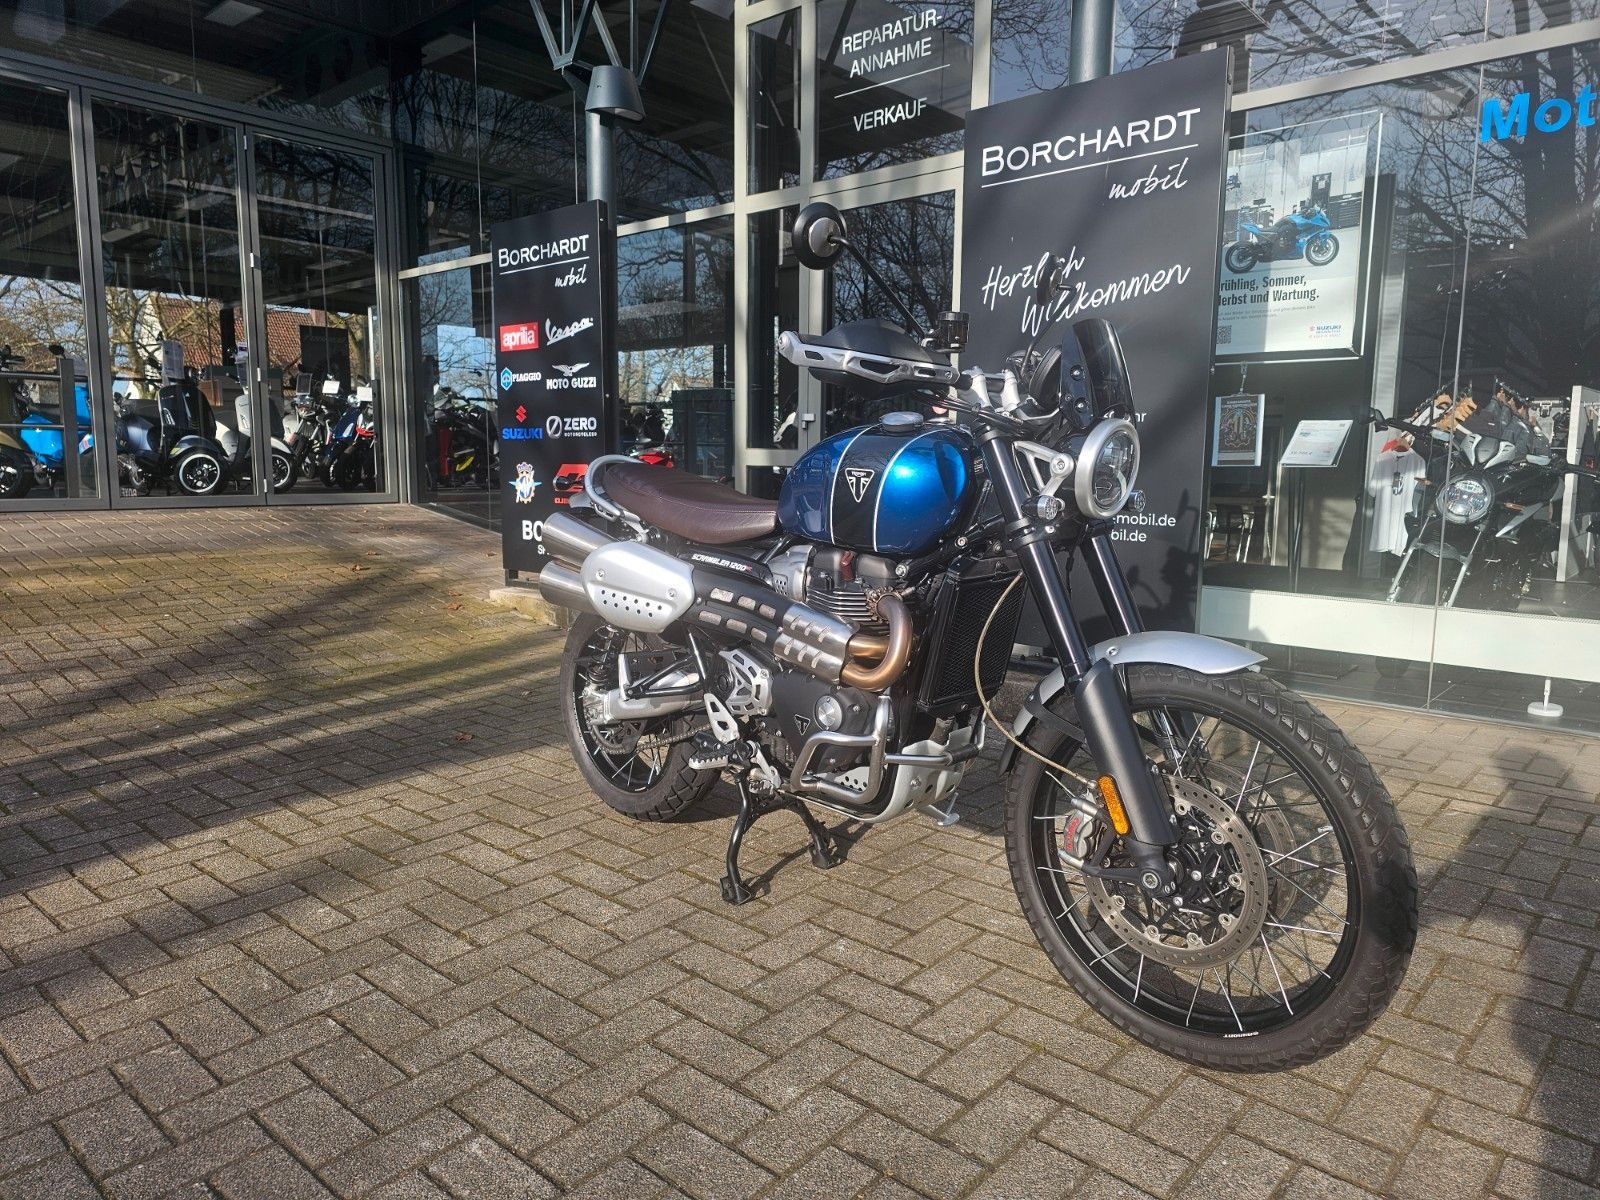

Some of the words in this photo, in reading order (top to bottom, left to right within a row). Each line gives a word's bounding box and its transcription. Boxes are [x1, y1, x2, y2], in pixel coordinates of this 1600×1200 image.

[841, 8, 943, 55] REPARATUR-
[849, 37, 933, 79] ANNAHME
[853, 97, 928, 132] VERKAUF
[1480, 83, 1597, 144] Mot
[981, 108, 1201, 177] BORCHARDT
[1108, 157, 1189, 200] mobil
[498, 234, 589, 268] BORCHARDT
[555, 264, 587, 287] mobil
[981, 246, 1085, 311] Herzlh
[1219, 278, 1259, 292] rühling,
[1262, 275, 1307, 288] Sommer,
[1250, 291, 1269, 303] und
[1273, 288, 1320, 302] Wartung.
[503, 327, 535, 350] aprilia
[545, 317, 593, 346] Vespa
[512, 371, 541, 382] PIAGGIO
[546, 378, 569, 390] MOTO
[571, 376, 596, 388] GUZZI
[502, 427, 543, 440] SUZUKI
[563, 416, 597, 431] ZERO
